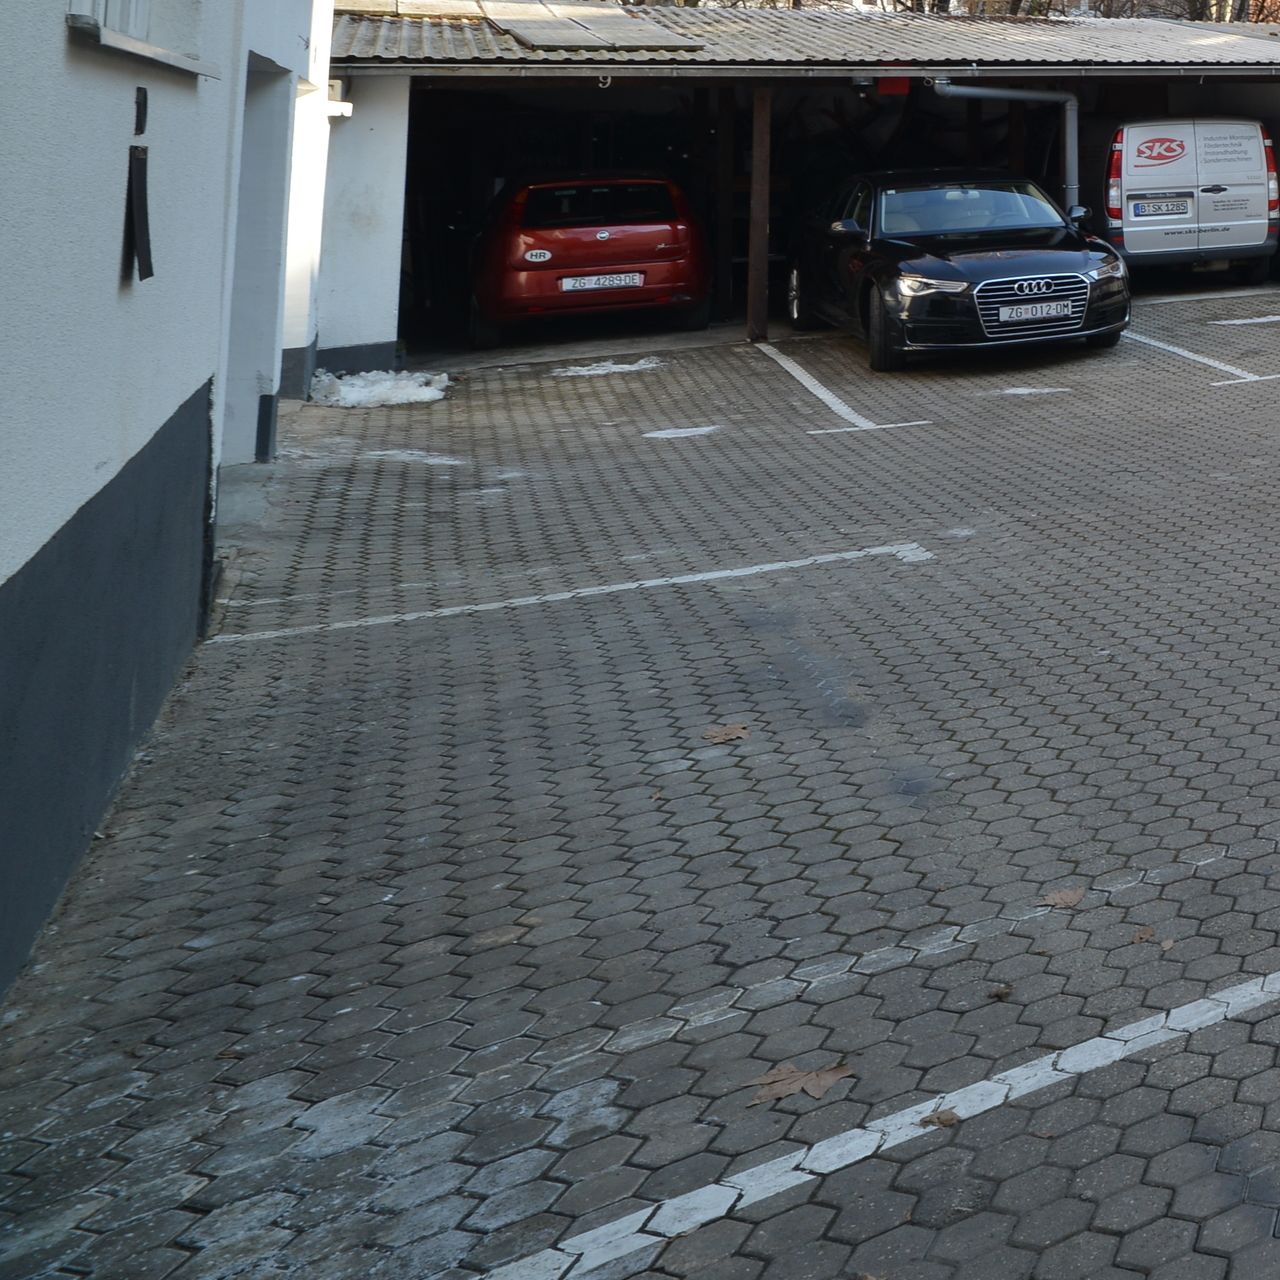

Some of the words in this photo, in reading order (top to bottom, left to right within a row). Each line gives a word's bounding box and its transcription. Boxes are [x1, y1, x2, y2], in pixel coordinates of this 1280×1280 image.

[1138, 141, 1184, 157] SKS
[1139, 204, 1147, 214] B
[1151, 204, 1164, 213] SK
[1165, 202, 1188, 212] 1285
[529, 252, 547, 260] HR
[571, 278, 587, 289] ZG
[593, 274, 638, 287] 4289-DE
[1007, 307, 1023, 319] ZG
